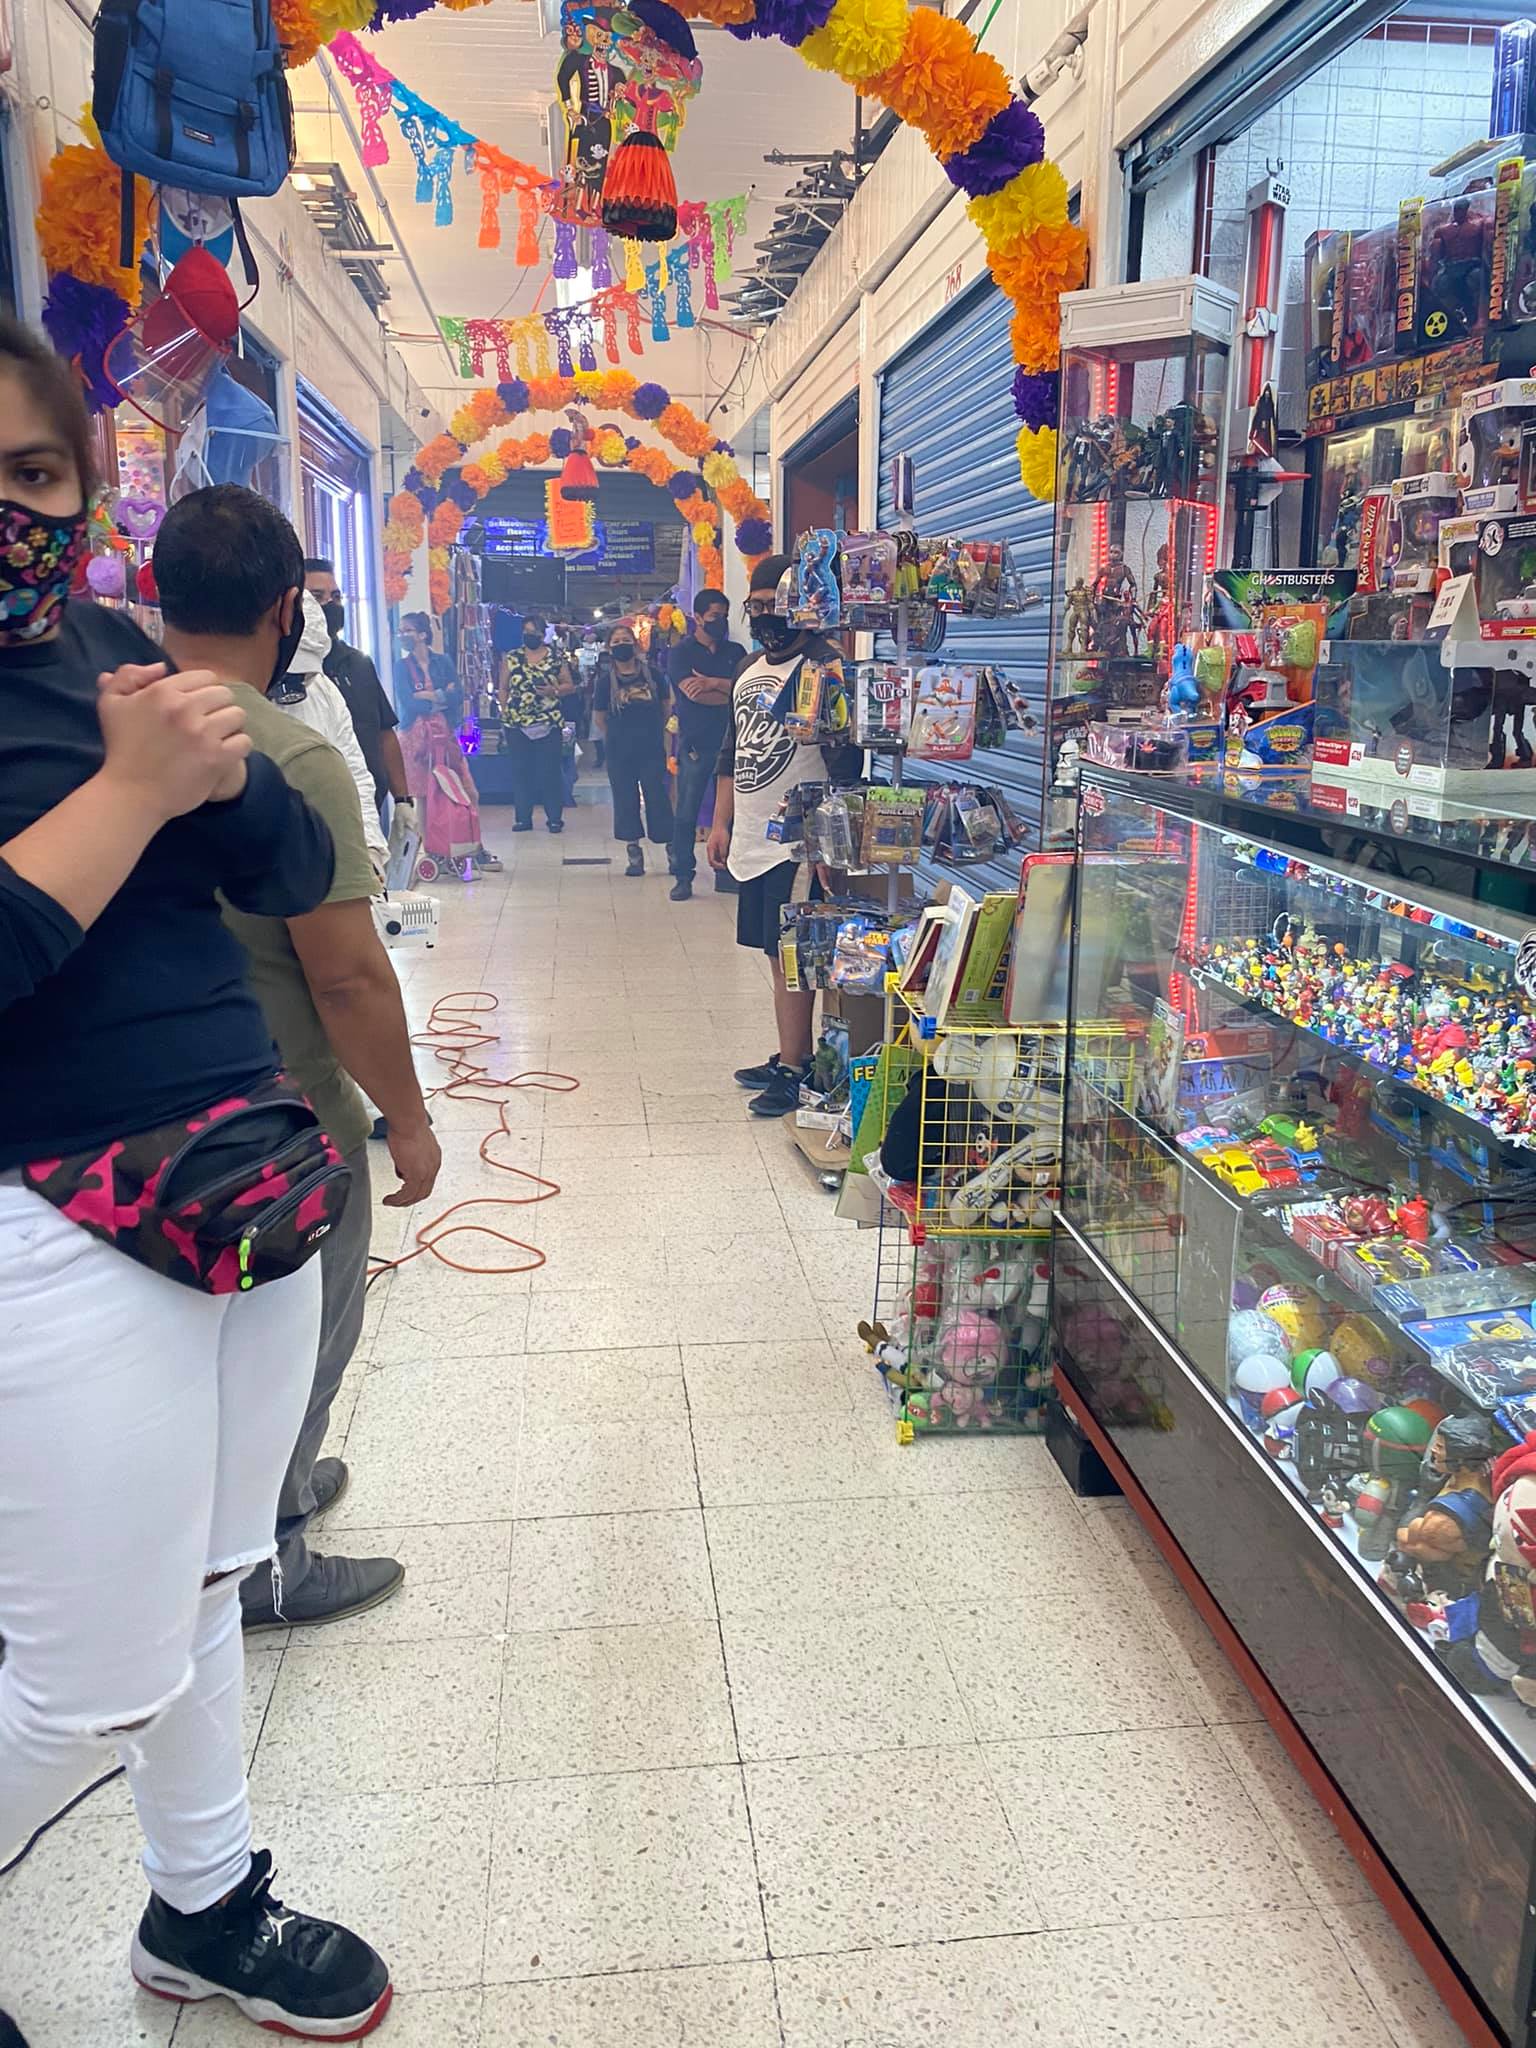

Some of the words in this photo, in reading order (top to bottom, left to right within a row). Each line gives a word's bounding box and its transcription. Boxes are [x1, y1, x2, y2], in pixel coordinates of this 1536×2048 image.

[1399, 233, 1418, 289] HULK
[1488, 188, 1511, 320] ABOMINATION
[1397, 291, 1415, 333] RED
[1251, 574, 1335, 586] GHOSTBUSTERS
